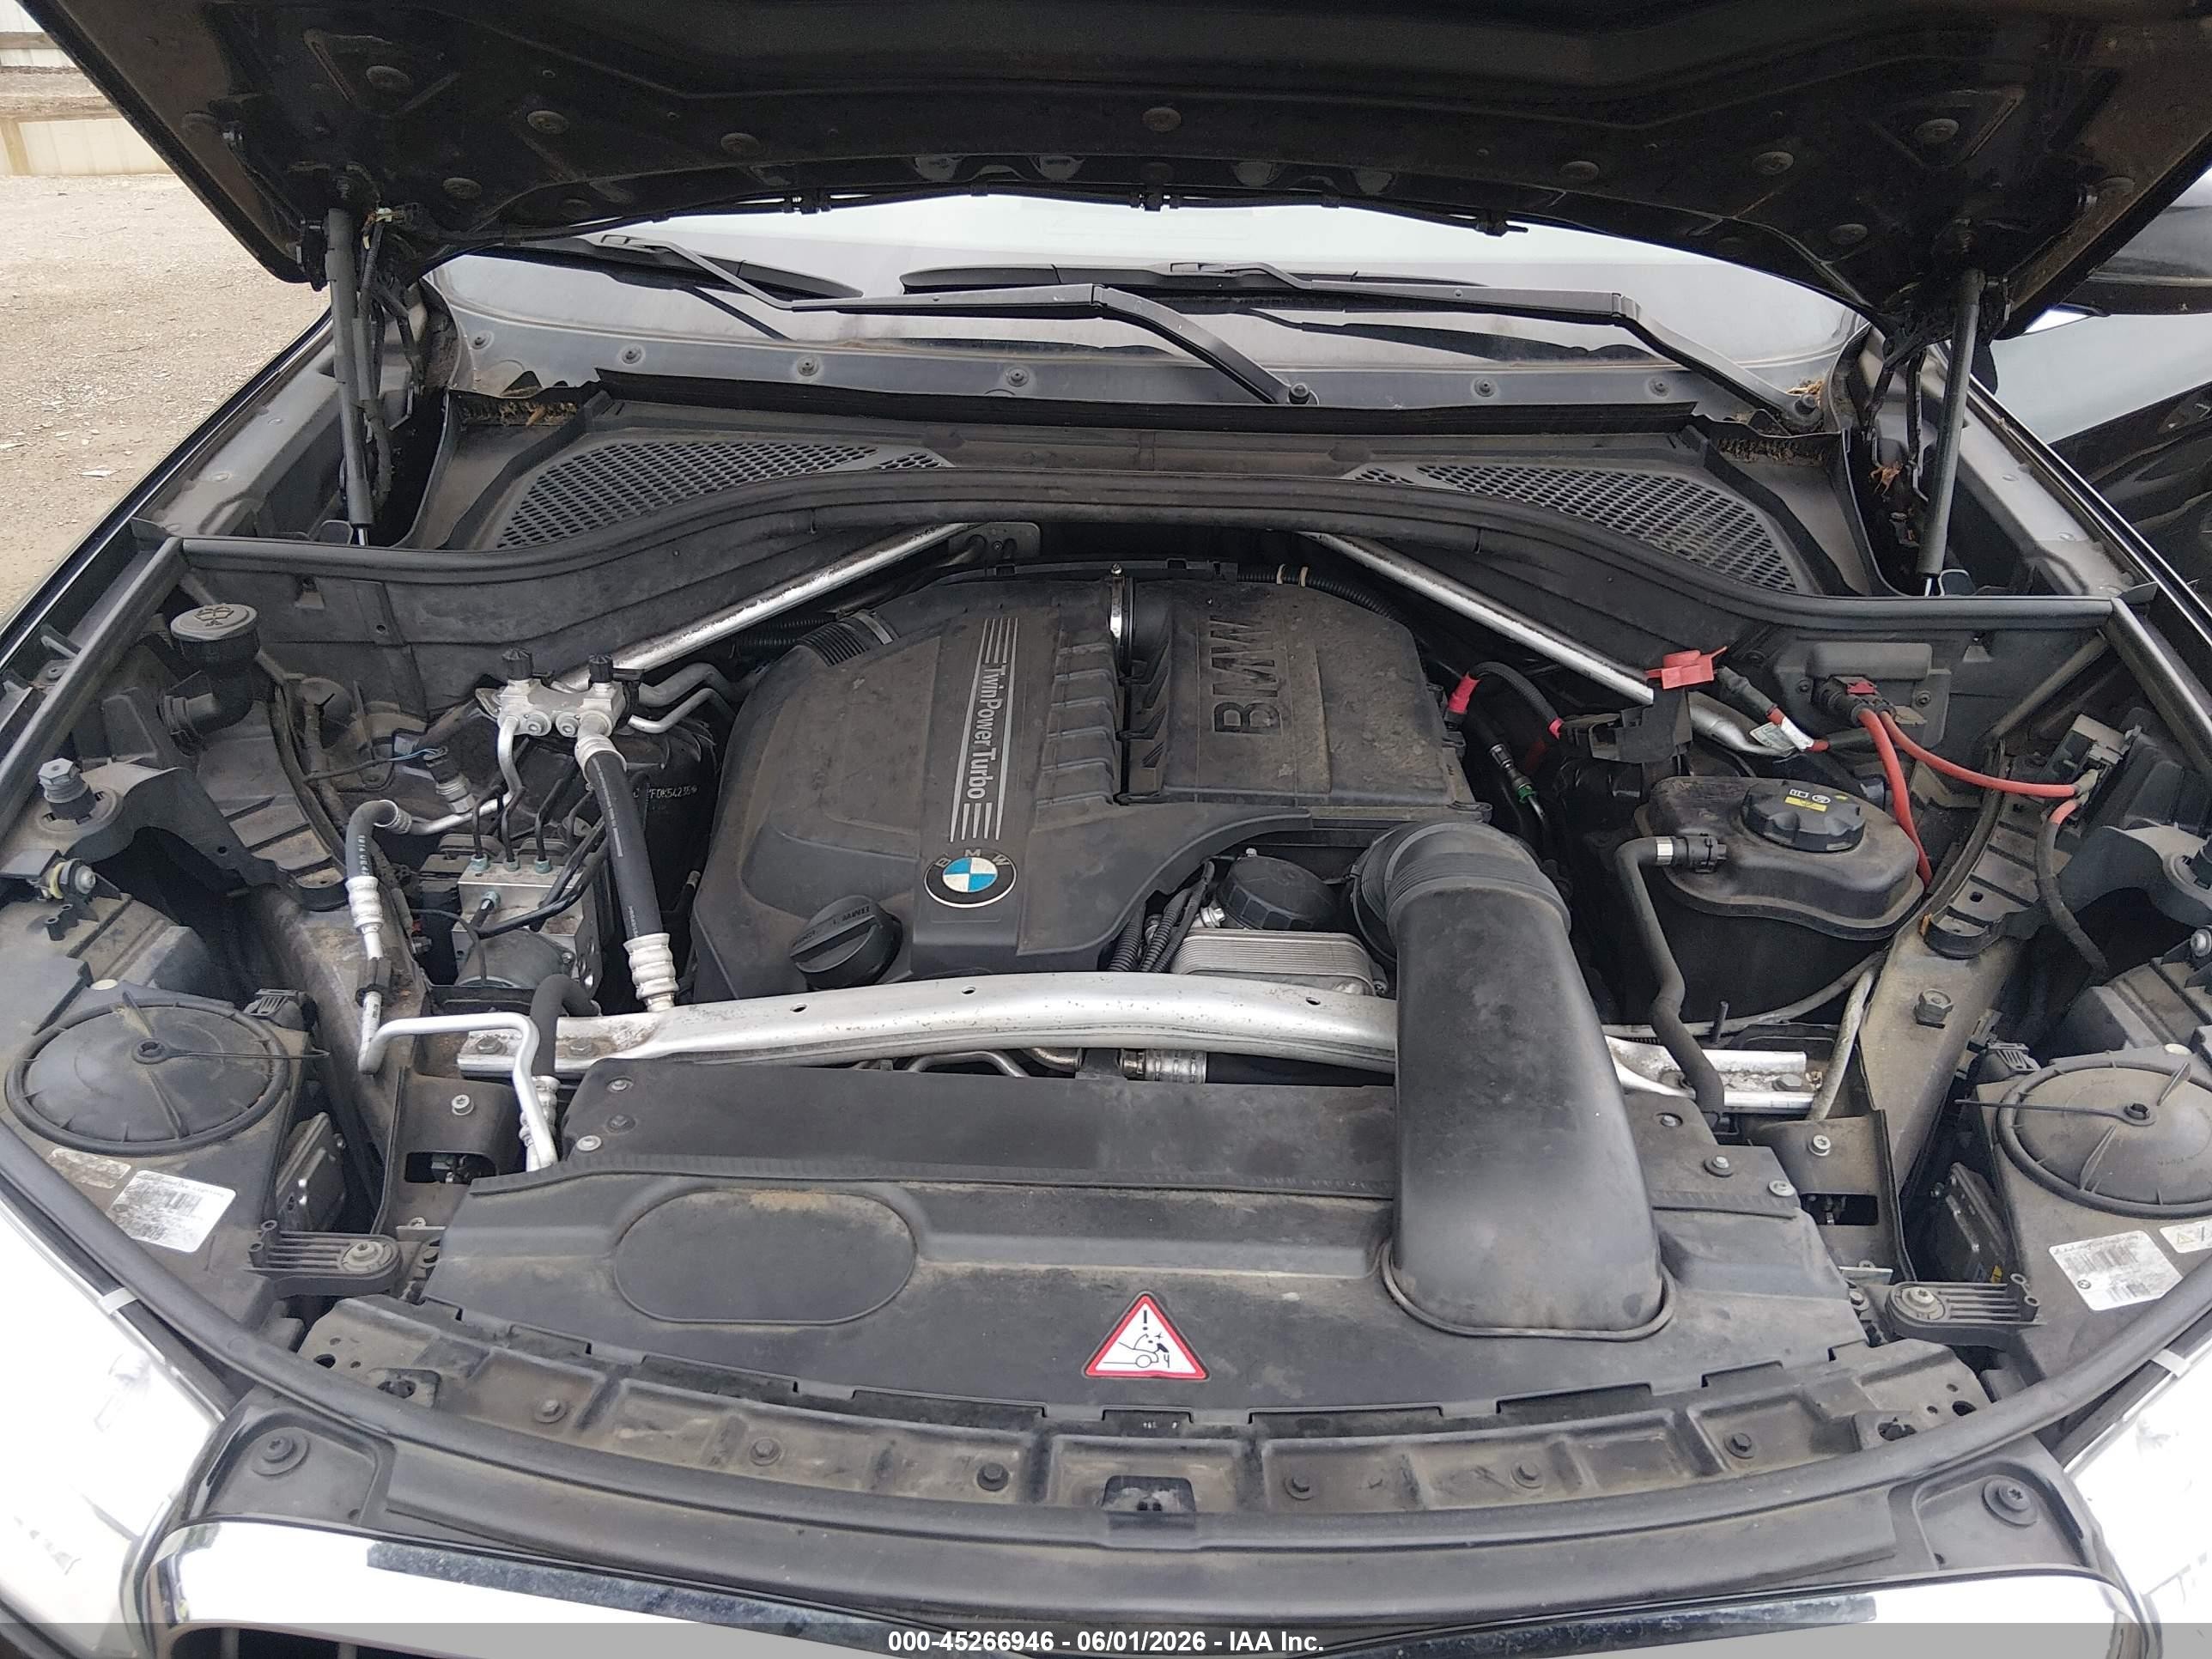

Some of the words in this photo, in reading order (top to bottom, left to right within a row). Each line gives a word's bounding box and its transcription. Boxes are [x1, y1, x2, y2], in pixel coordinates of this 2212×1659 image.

[974, 665, 1008, 747] TwinPower
[1209, 616, 1281, 736] BMW
[966, 745, 999, 799] Turbo
[934, 848, 1012, 869] BMW
